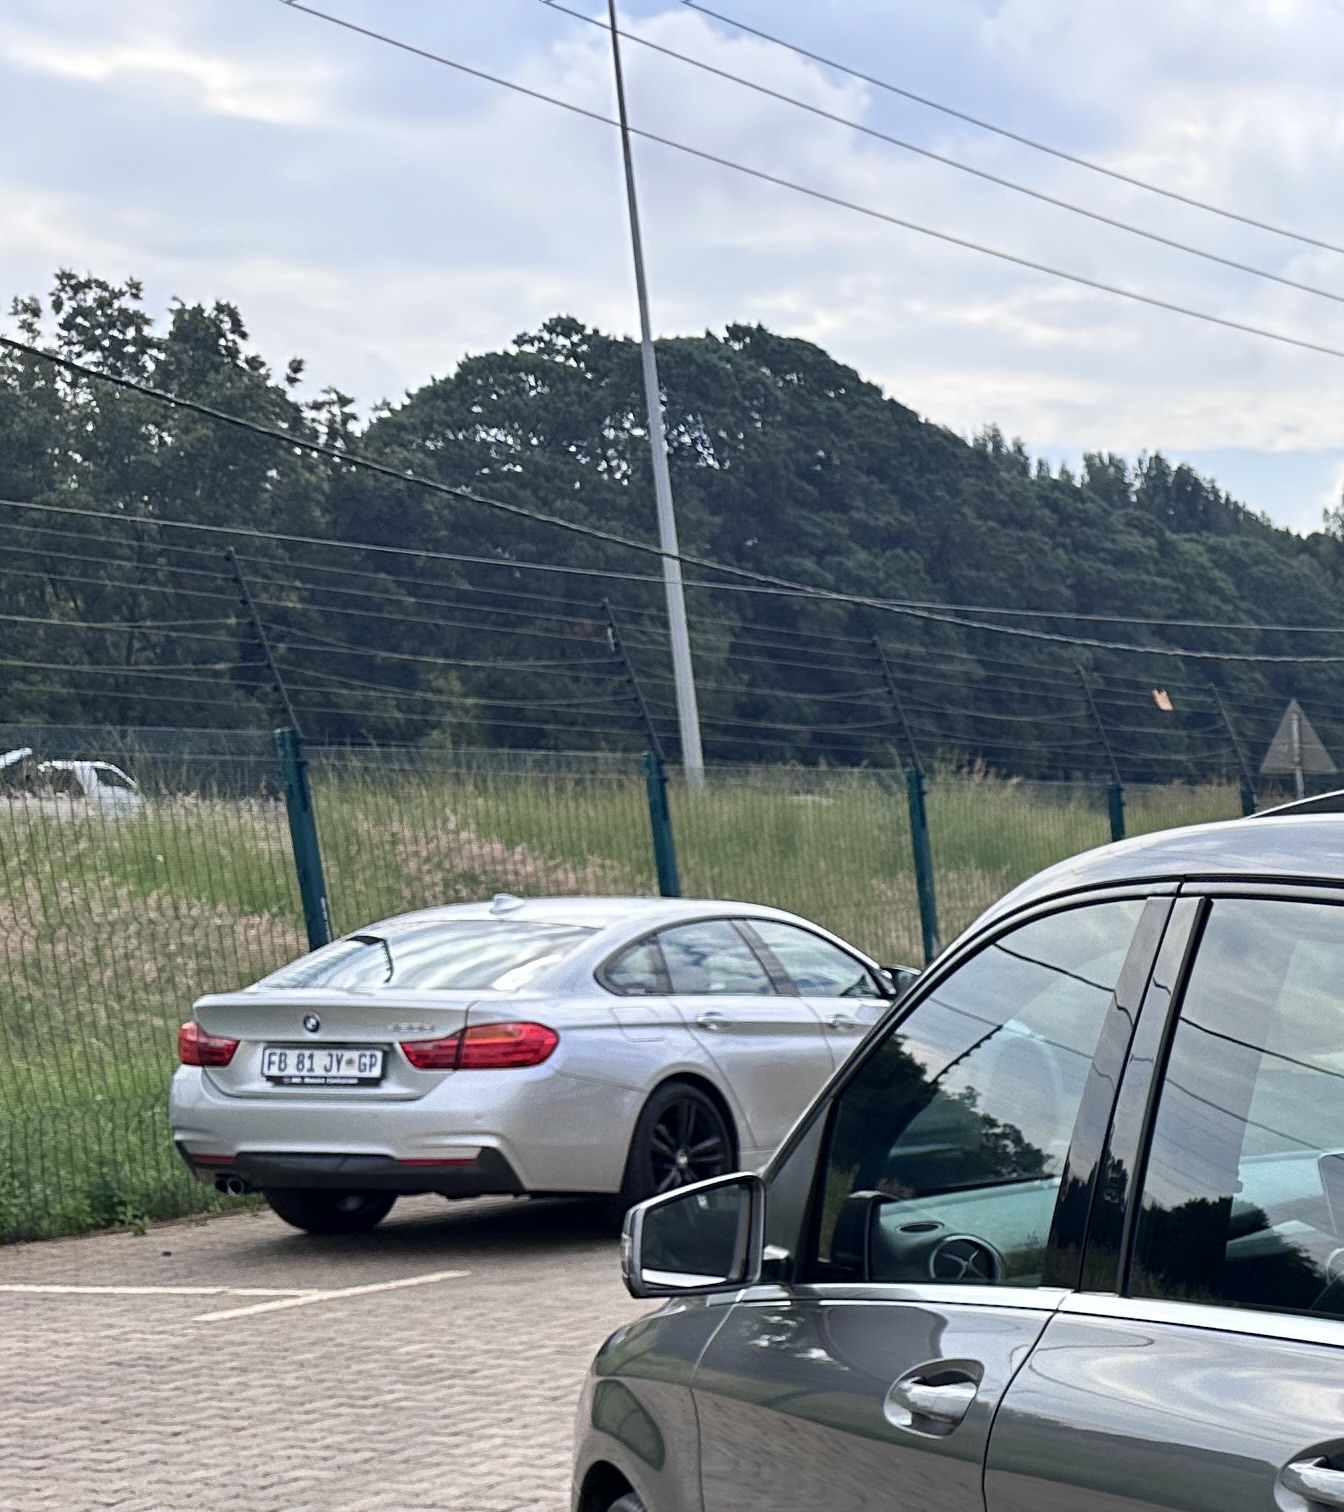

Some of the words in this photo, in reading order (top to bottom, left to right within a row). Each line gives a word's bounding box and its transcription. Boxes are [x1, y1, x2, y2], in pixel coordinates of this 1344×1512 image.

[267, 1052, 288, 1073] FB
[296, 1052, 315, 1073] 81
[324, 1053, 344, 1073] JY
[358, 1053, 378, 1073] GP
